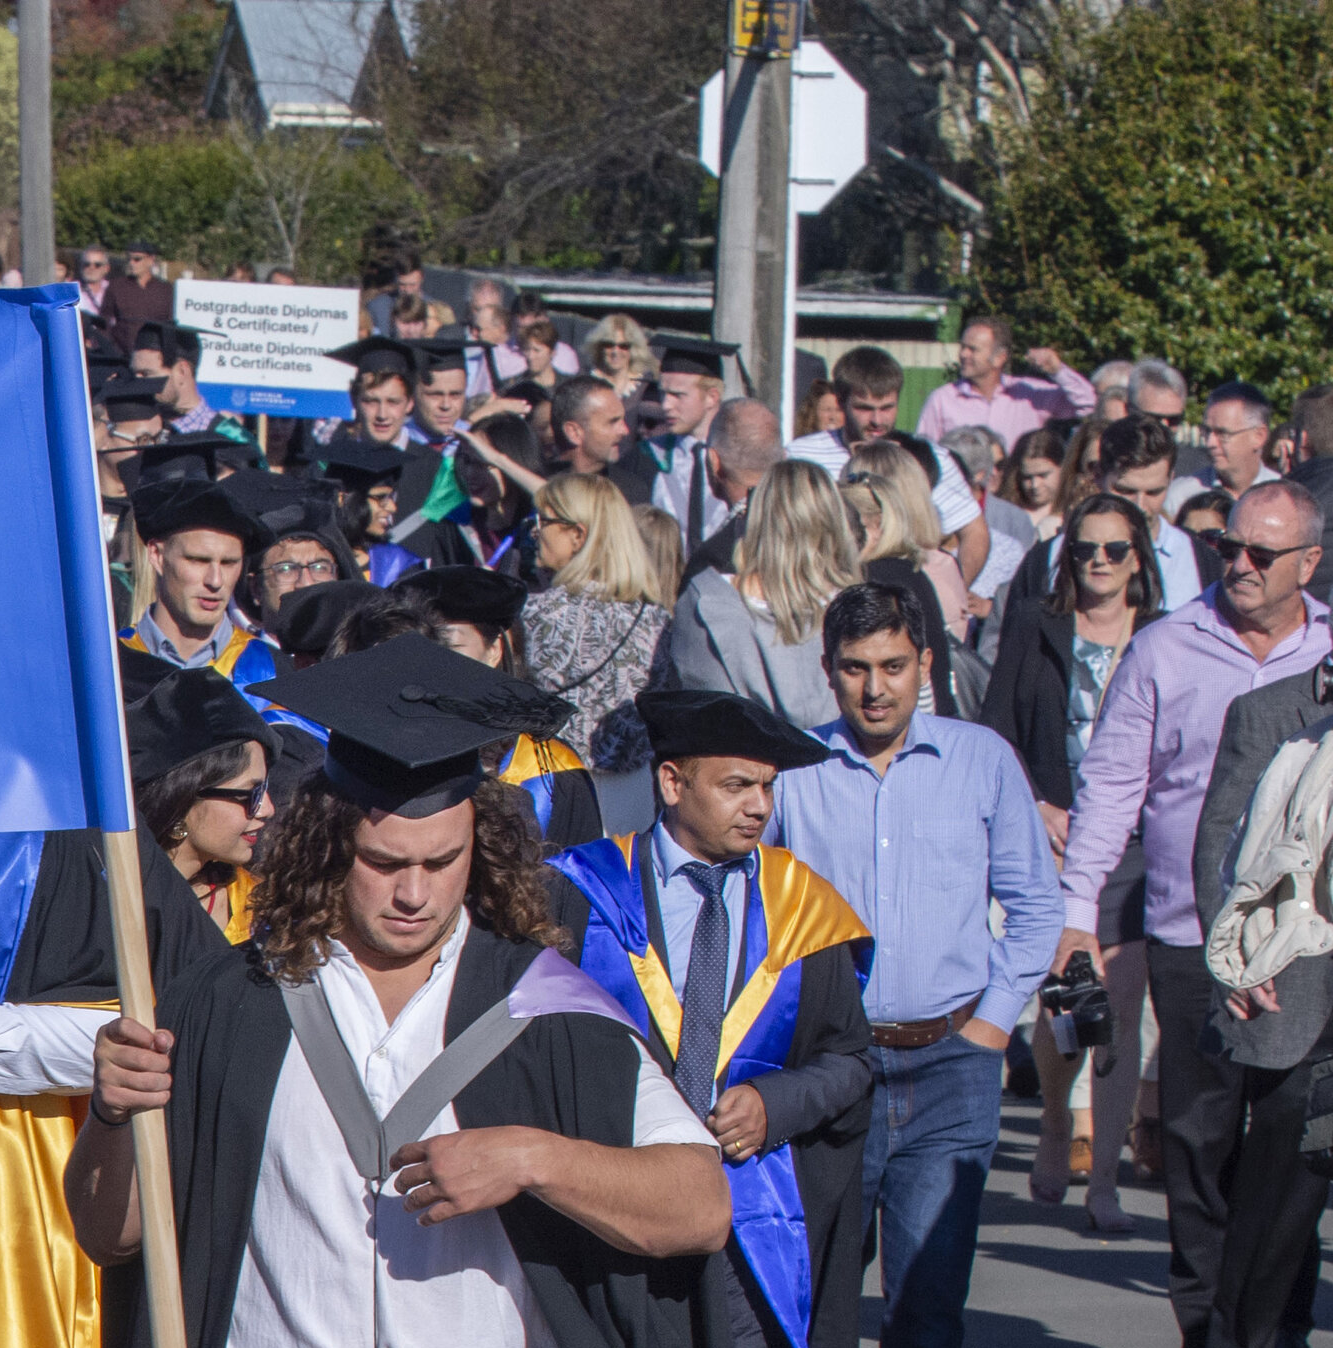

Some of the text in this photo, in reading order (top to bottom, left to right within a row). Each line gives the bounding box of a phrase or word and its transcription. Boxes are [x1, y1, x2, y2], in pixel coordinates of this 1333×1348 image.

[184, 298, 349, 320] Postgraduate Diplomas
[213, 317, 223, 328] &
[226, 317, 309, 334] Certificates
[217, 356, 313, 372] & Certificates
